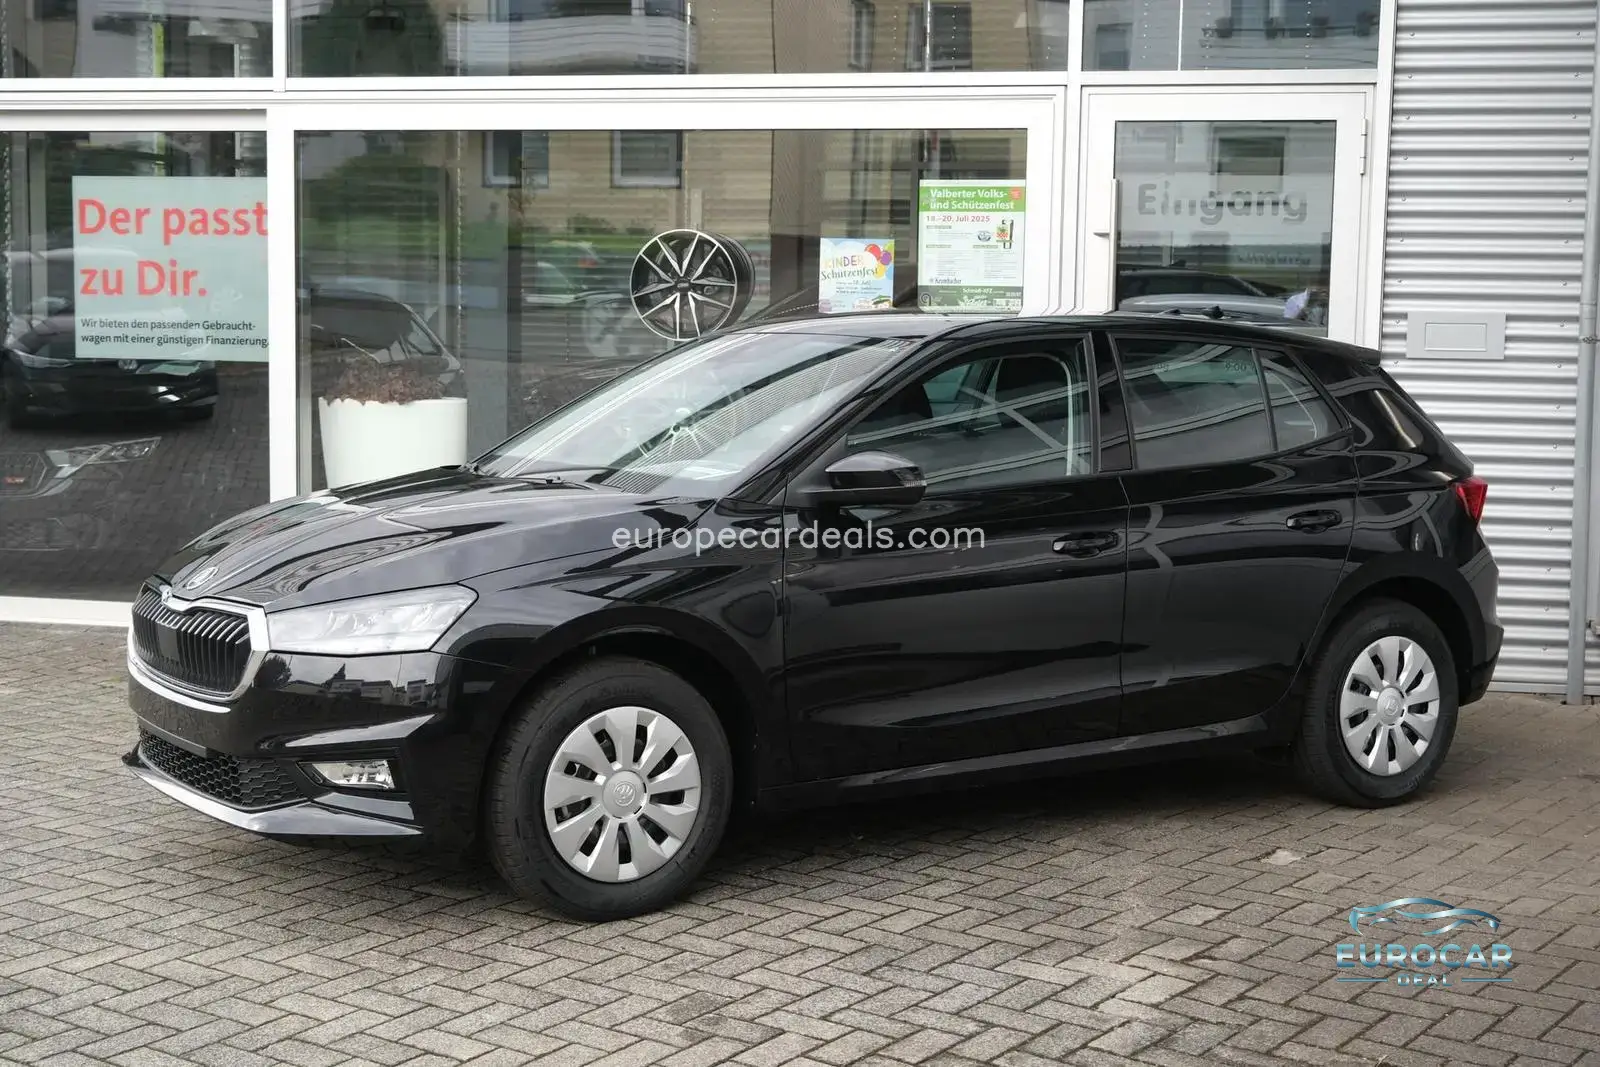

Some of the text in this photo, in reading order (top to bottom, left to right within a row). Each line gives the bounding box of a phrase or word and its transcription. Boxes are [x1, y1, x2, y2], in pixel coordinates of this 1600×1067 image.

[930, 189, 1007, 198] Valberter Volks-
[930, 200, 1014, 209] und Schützenfest
[1138, 180, 1308, 226] Eingang
[78, 199, 268, 246] Der passt
[971, 215, 991, 223] 2025
[80, 258, 208, 297] zu Dir.
[81, 319, 256, 331] Wir bieten den passenden Gebraucht-
[81, 335, 112, 345] wagen
[113, 333, 129, 343] mit
[131, 334, 155, 344] einer
[156, 334, 204, 347] günstigen
